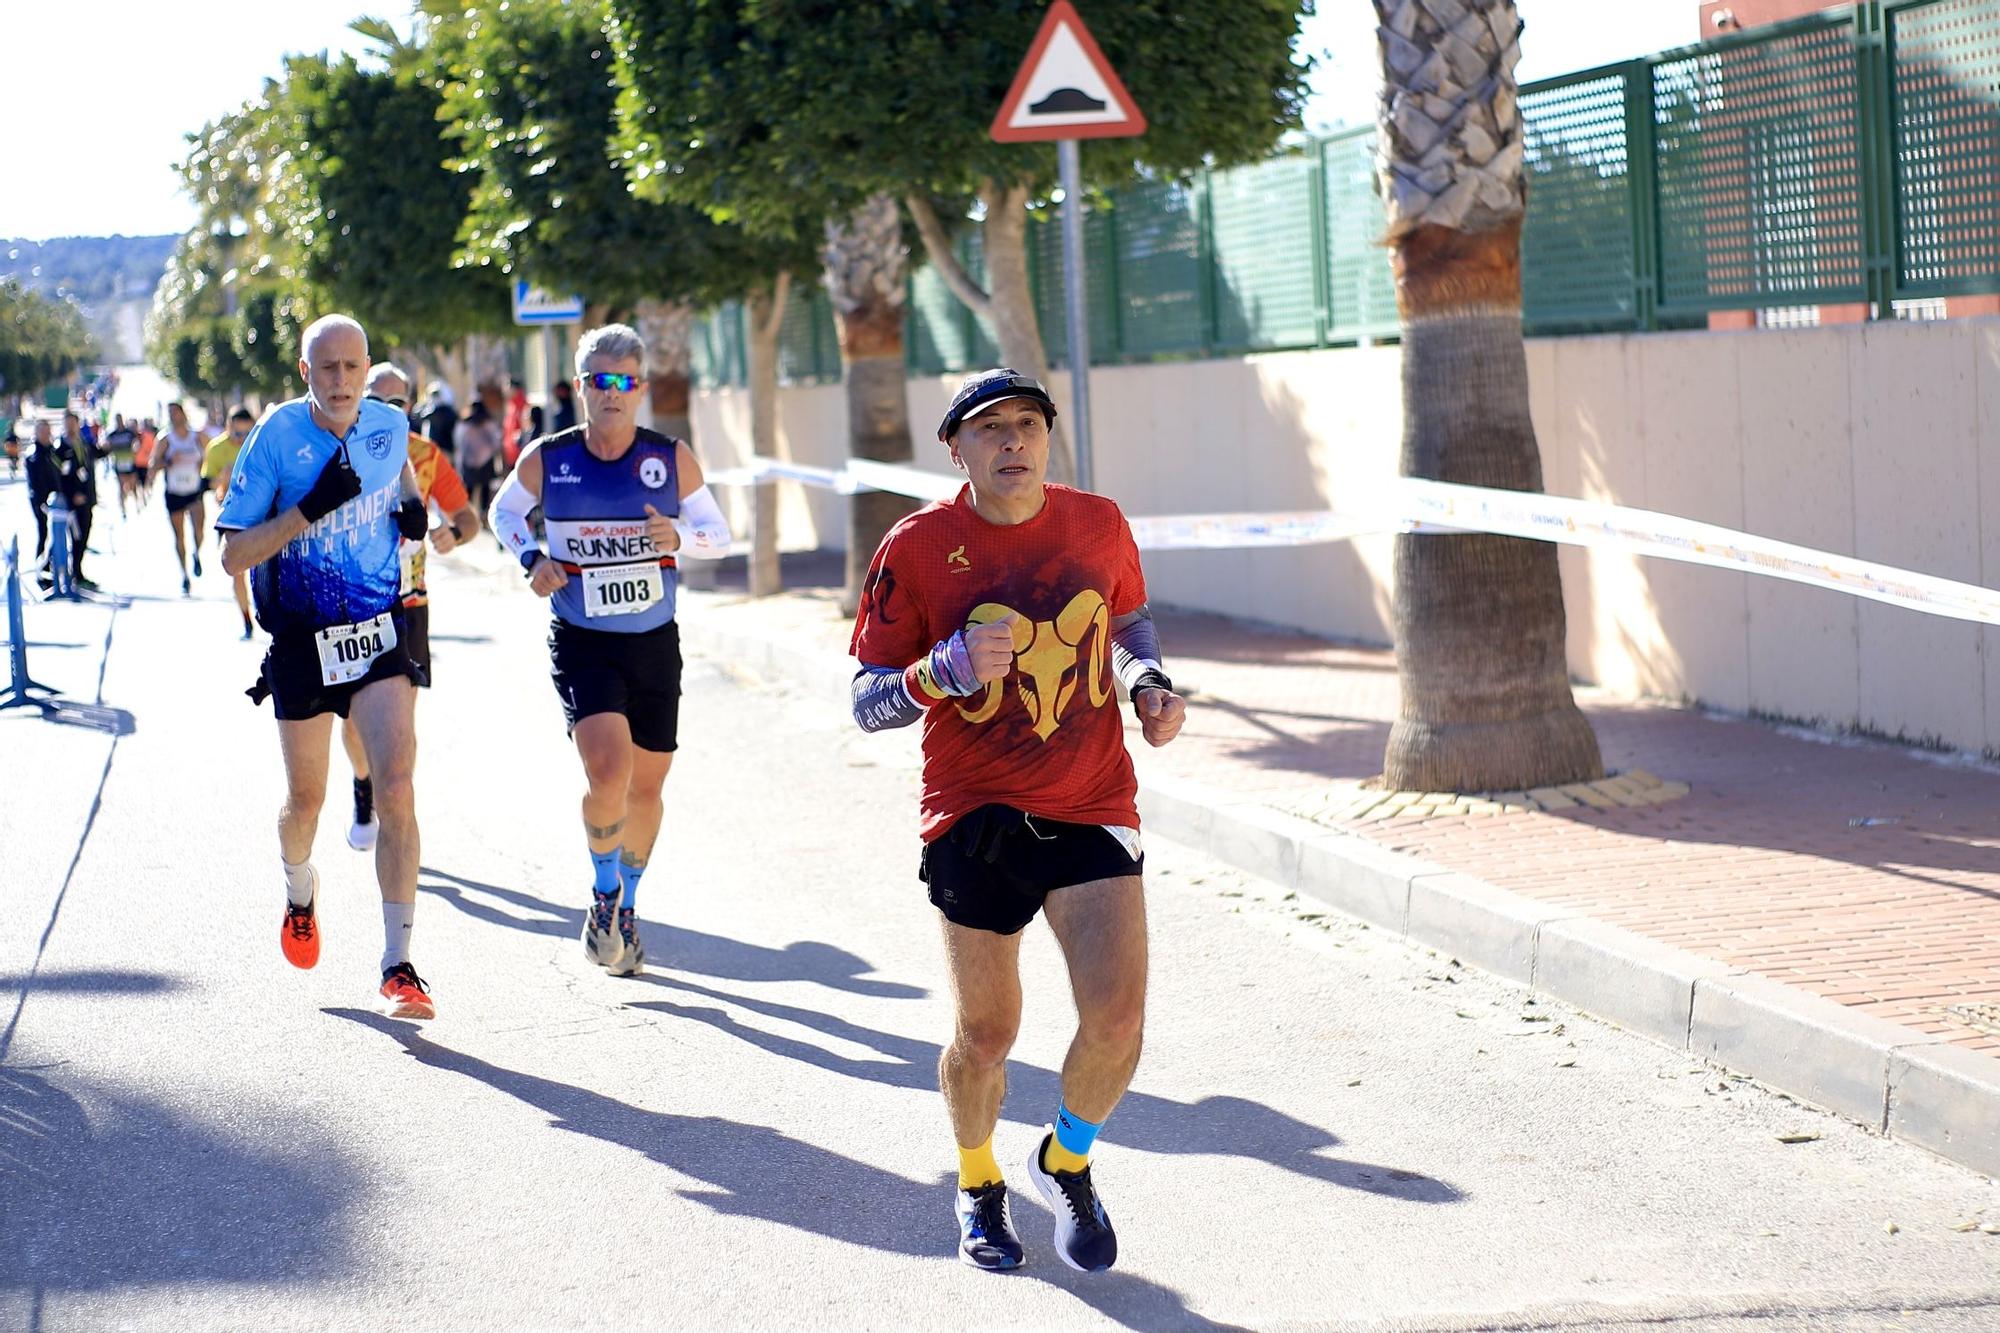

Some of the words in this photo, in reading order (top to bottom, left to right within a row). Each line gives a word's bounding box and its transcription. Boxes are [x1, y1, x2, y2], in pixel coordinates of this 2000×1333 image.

[371, 436, 386, 450] SR
[579, 526, 647, 537] SIMPLEMENT
[597, 578, 650, 605] 1003
[333, 632, 384, 663] 1094
